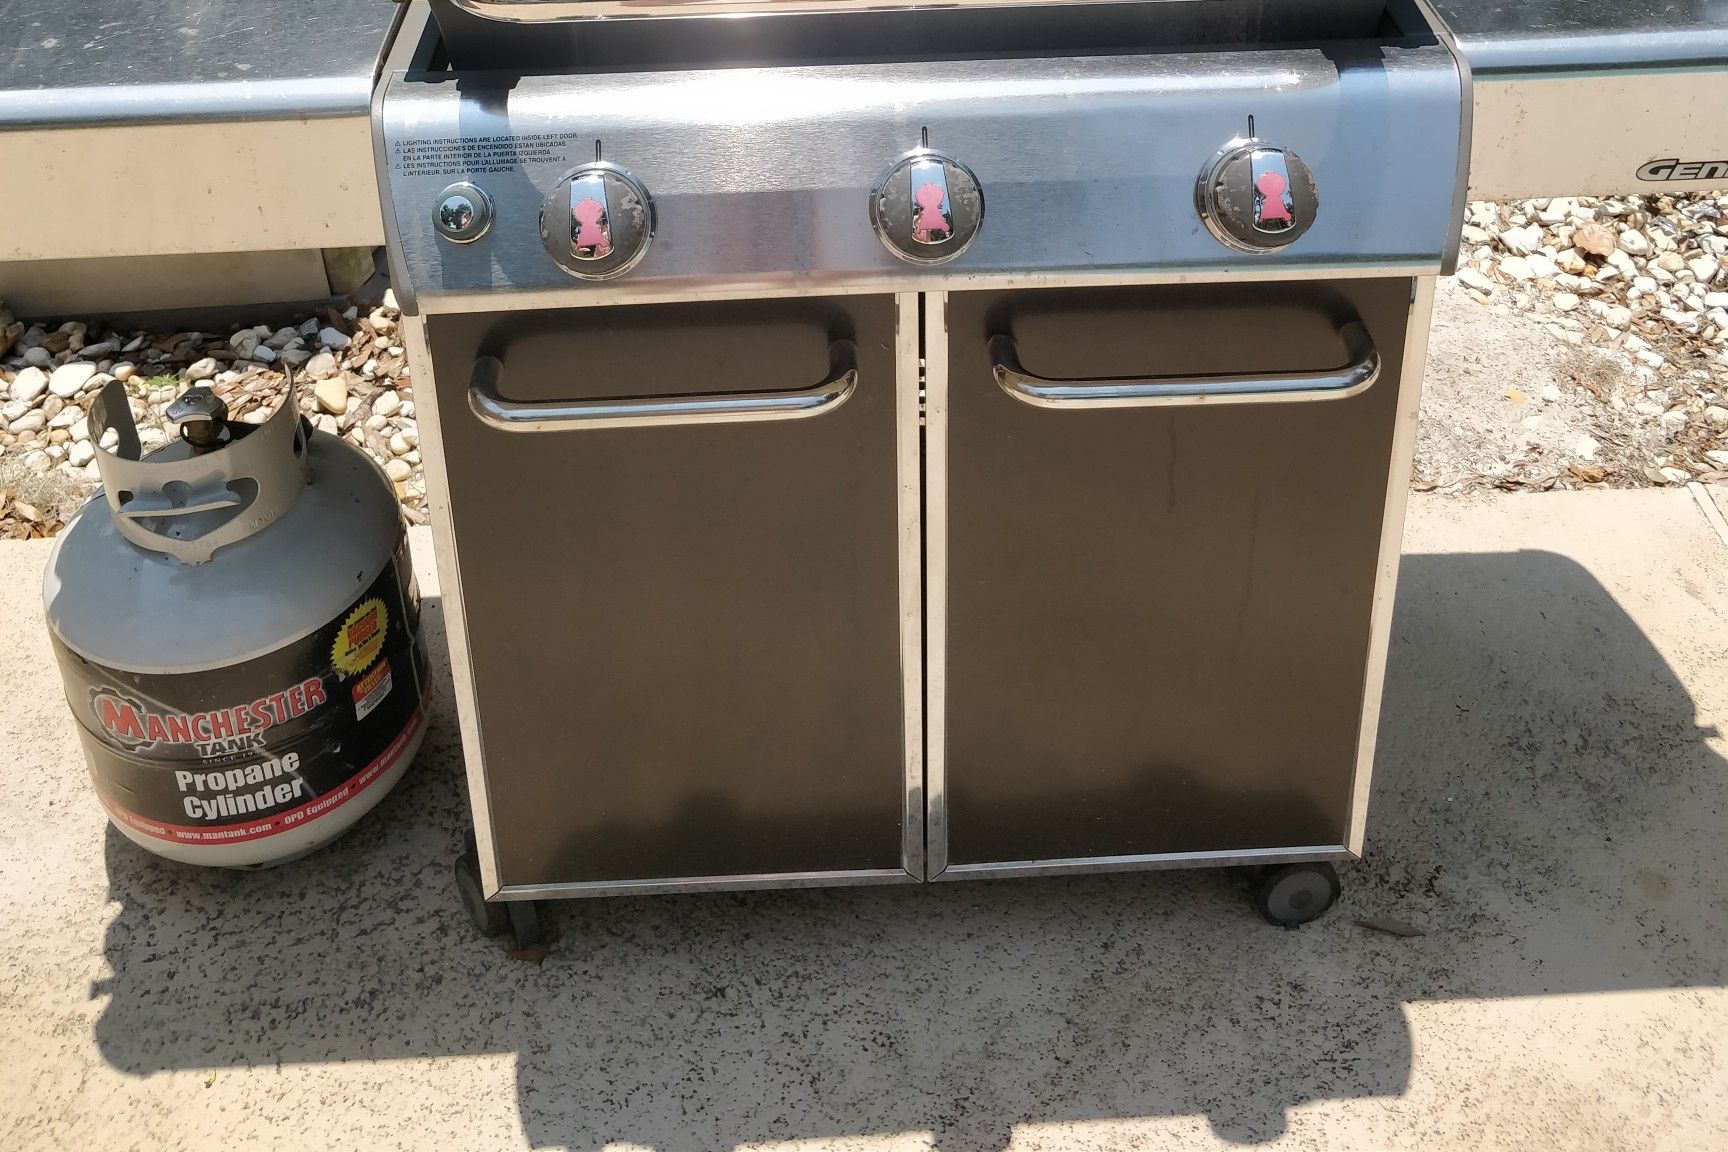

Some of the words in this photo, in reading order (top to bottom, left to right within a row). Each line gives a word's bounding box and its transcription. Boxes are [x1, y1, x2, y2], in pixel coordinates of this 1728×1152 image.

[416, 145, 467, 153] INSTRUCCIONES
[535, 140, 567, 148] UBICADAS
[416, 160, 462, 168] INSTRUCTIONS
[101, 677, 327, 744] MANCHESTER
[194, 731, 266, 758] TANK
[174, 750, 301, 793] Propane
[176, 821, 273, 841] www.mantank.com
[284, 808, 305, 826] OPD
[305, 786, 350, 817] Equipped
[182, 776, 304, 822] Cylinder
